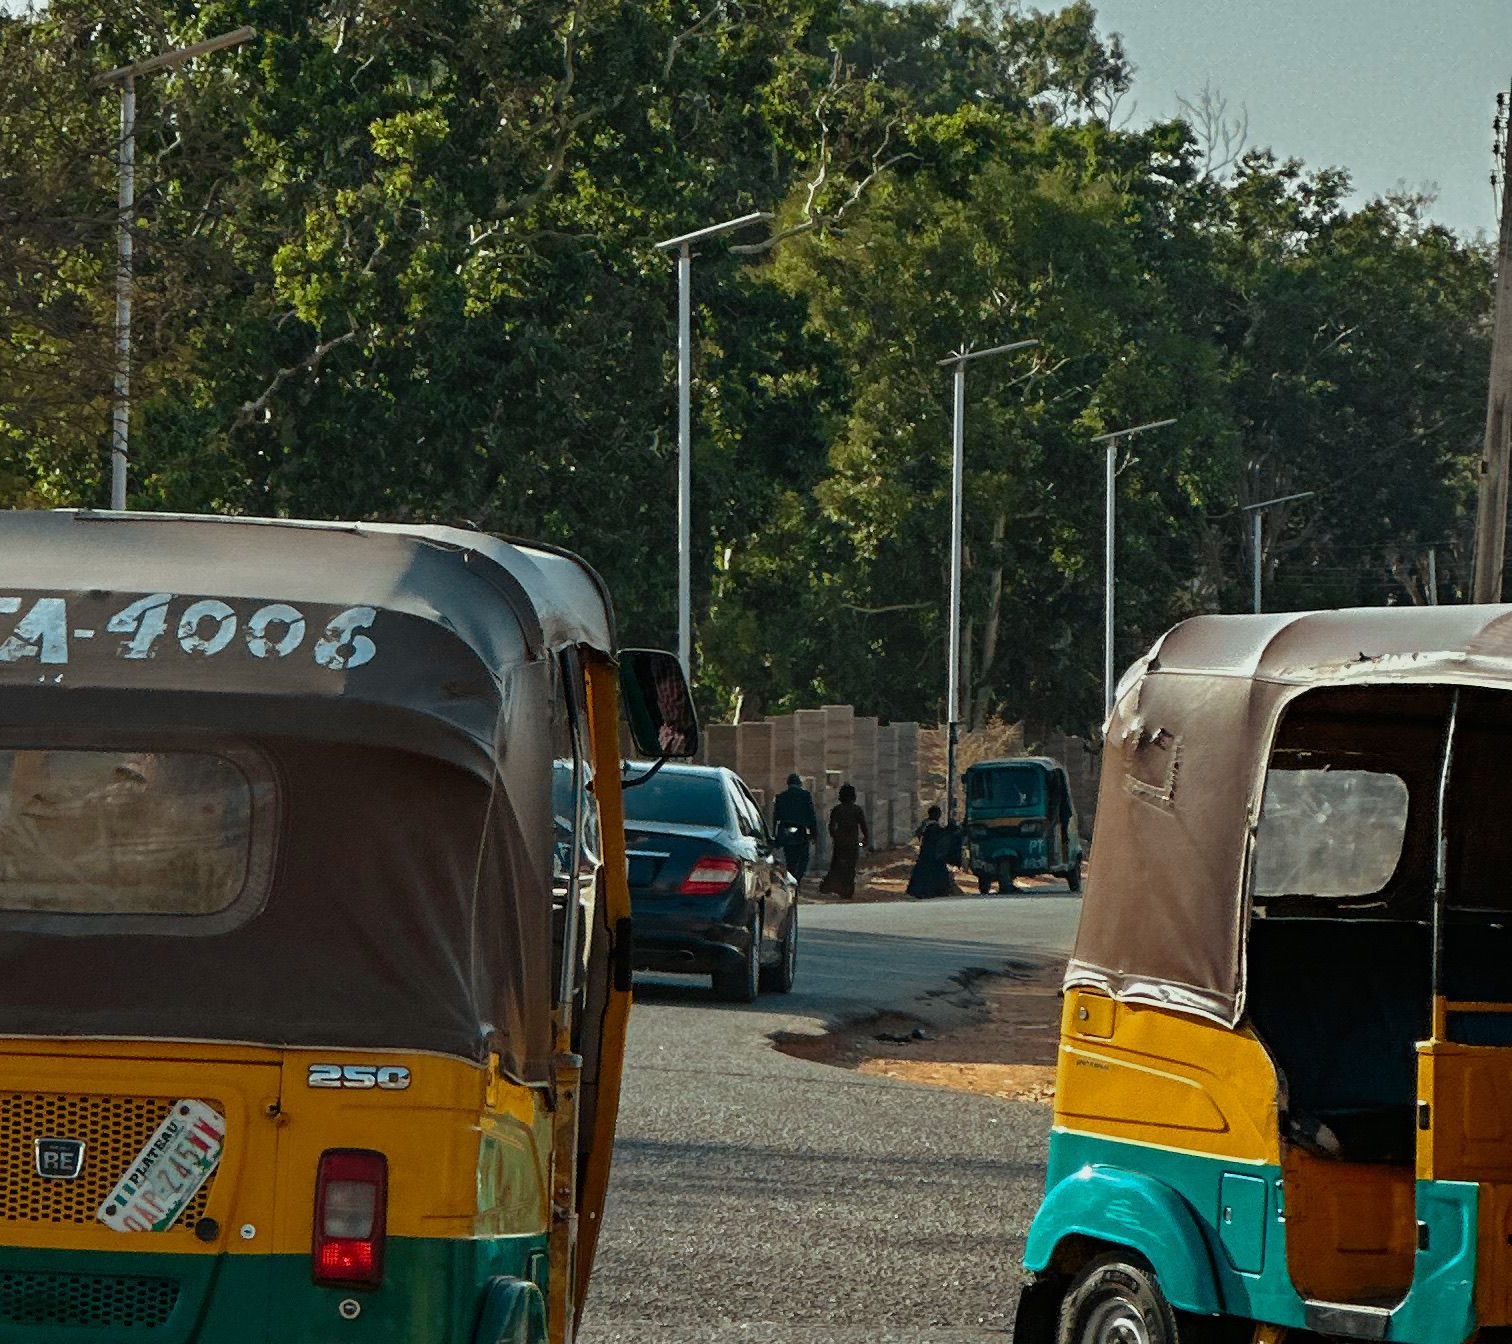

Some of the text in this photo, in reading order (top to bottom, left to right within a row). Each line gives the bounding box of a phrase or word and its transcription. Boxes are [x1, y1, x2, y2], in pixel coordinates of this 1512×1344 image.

[309, 1064, 410, 1090] 250
[43, 1151, 74, 1170] RE
[129, 1121, 179, 1185] PLATEAU
